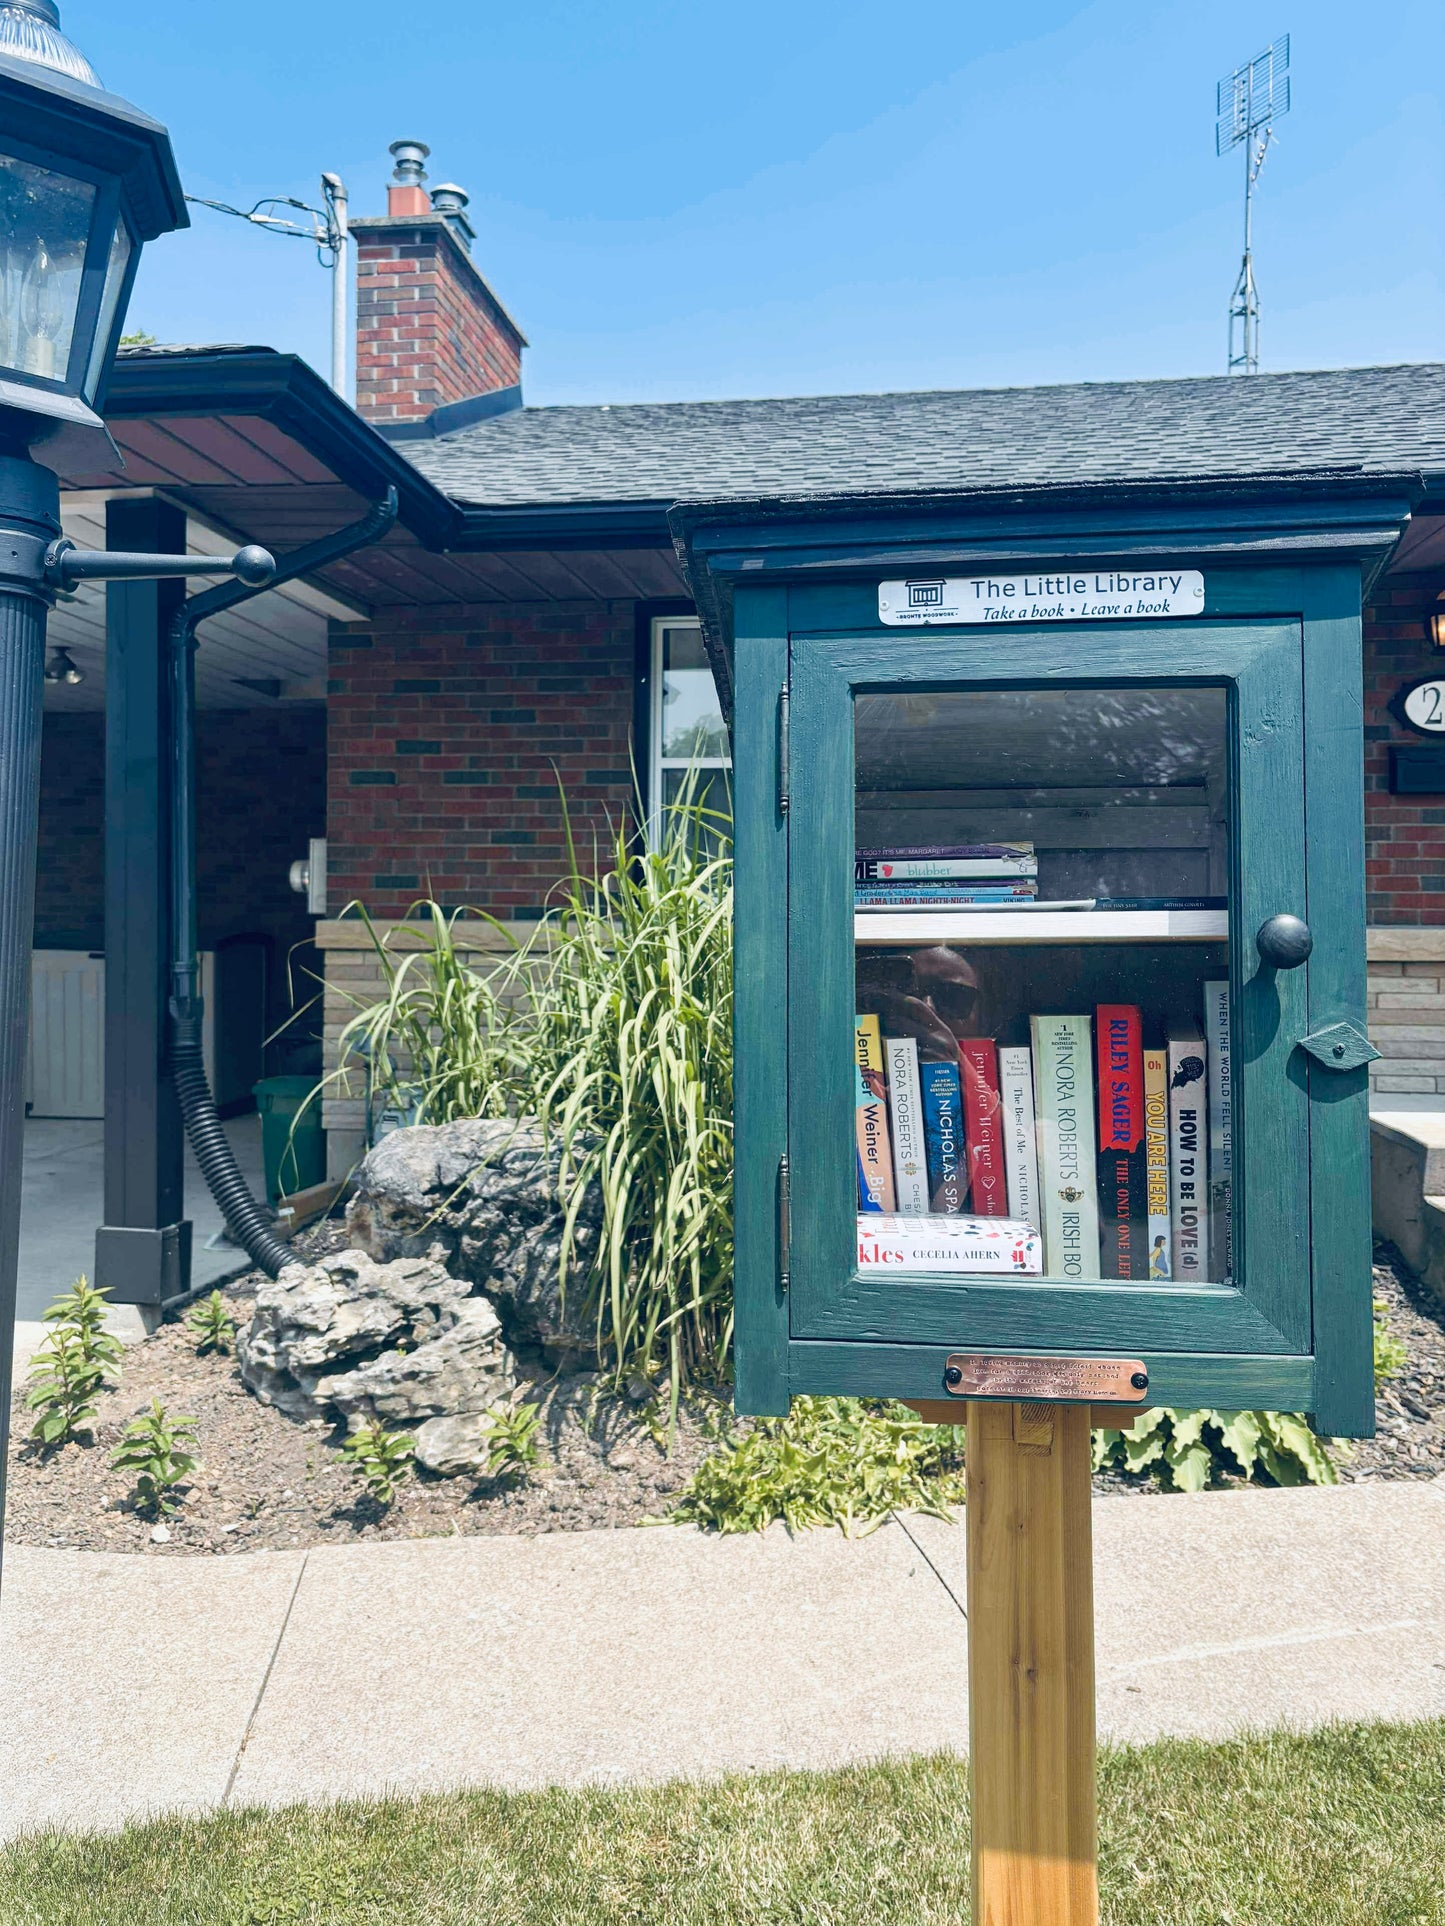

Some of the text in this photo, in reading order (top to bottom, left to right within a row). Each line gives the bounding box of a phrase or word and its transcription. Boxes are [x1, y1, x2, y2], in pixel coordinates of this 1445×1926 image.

[970, 574, 1182, 598] The Little Library
[984, 599, 1170, 620] Take a book Leave a book
[1422, 686, 1442, 725] 2
[907, 862, 952, 876] blubber
[860, 897, 887, 905] LLAMA
[890, 897, 917, 905] LLAMA
[1148, 1061, 1161, 1070] Oh
[972, 1053, 991, 1111] jennifer
[1108, 1019, 1131, 1142] RILEY SAGER
[1219, 992, 1232, 1170] WHEN THE WORLD FELL SILENT
[893, 1048, 912, 1160] NORA ROBERTS
[1014, 1087, 1023, 1104] The
[857, 1031, 885, 1203] Jennifer Weiner Big
[1015, 1107, 1024, 1126] Best
[939, 1100, 956, 1182] NICHOLAS
[1017, 1129, 1025, 1137] of
[1180, 1109, 1197, 1152] HOW
[1018, 1139, 1026, 1154] Me
[1146, 1091, 1168, 1215] YOU ARE HERE
[1056, 1053, 1082, 1279] NORA ROBERTS IRISH BO
[1180, 1158, 1195, 1176] TO
[1181, 1182, 1195, 1200] BE
[1116, 1159, 1131, 1280] THE ONLY ONE LEF
[859, 1244, 1000, 1263] kles CECELIA AHERN
